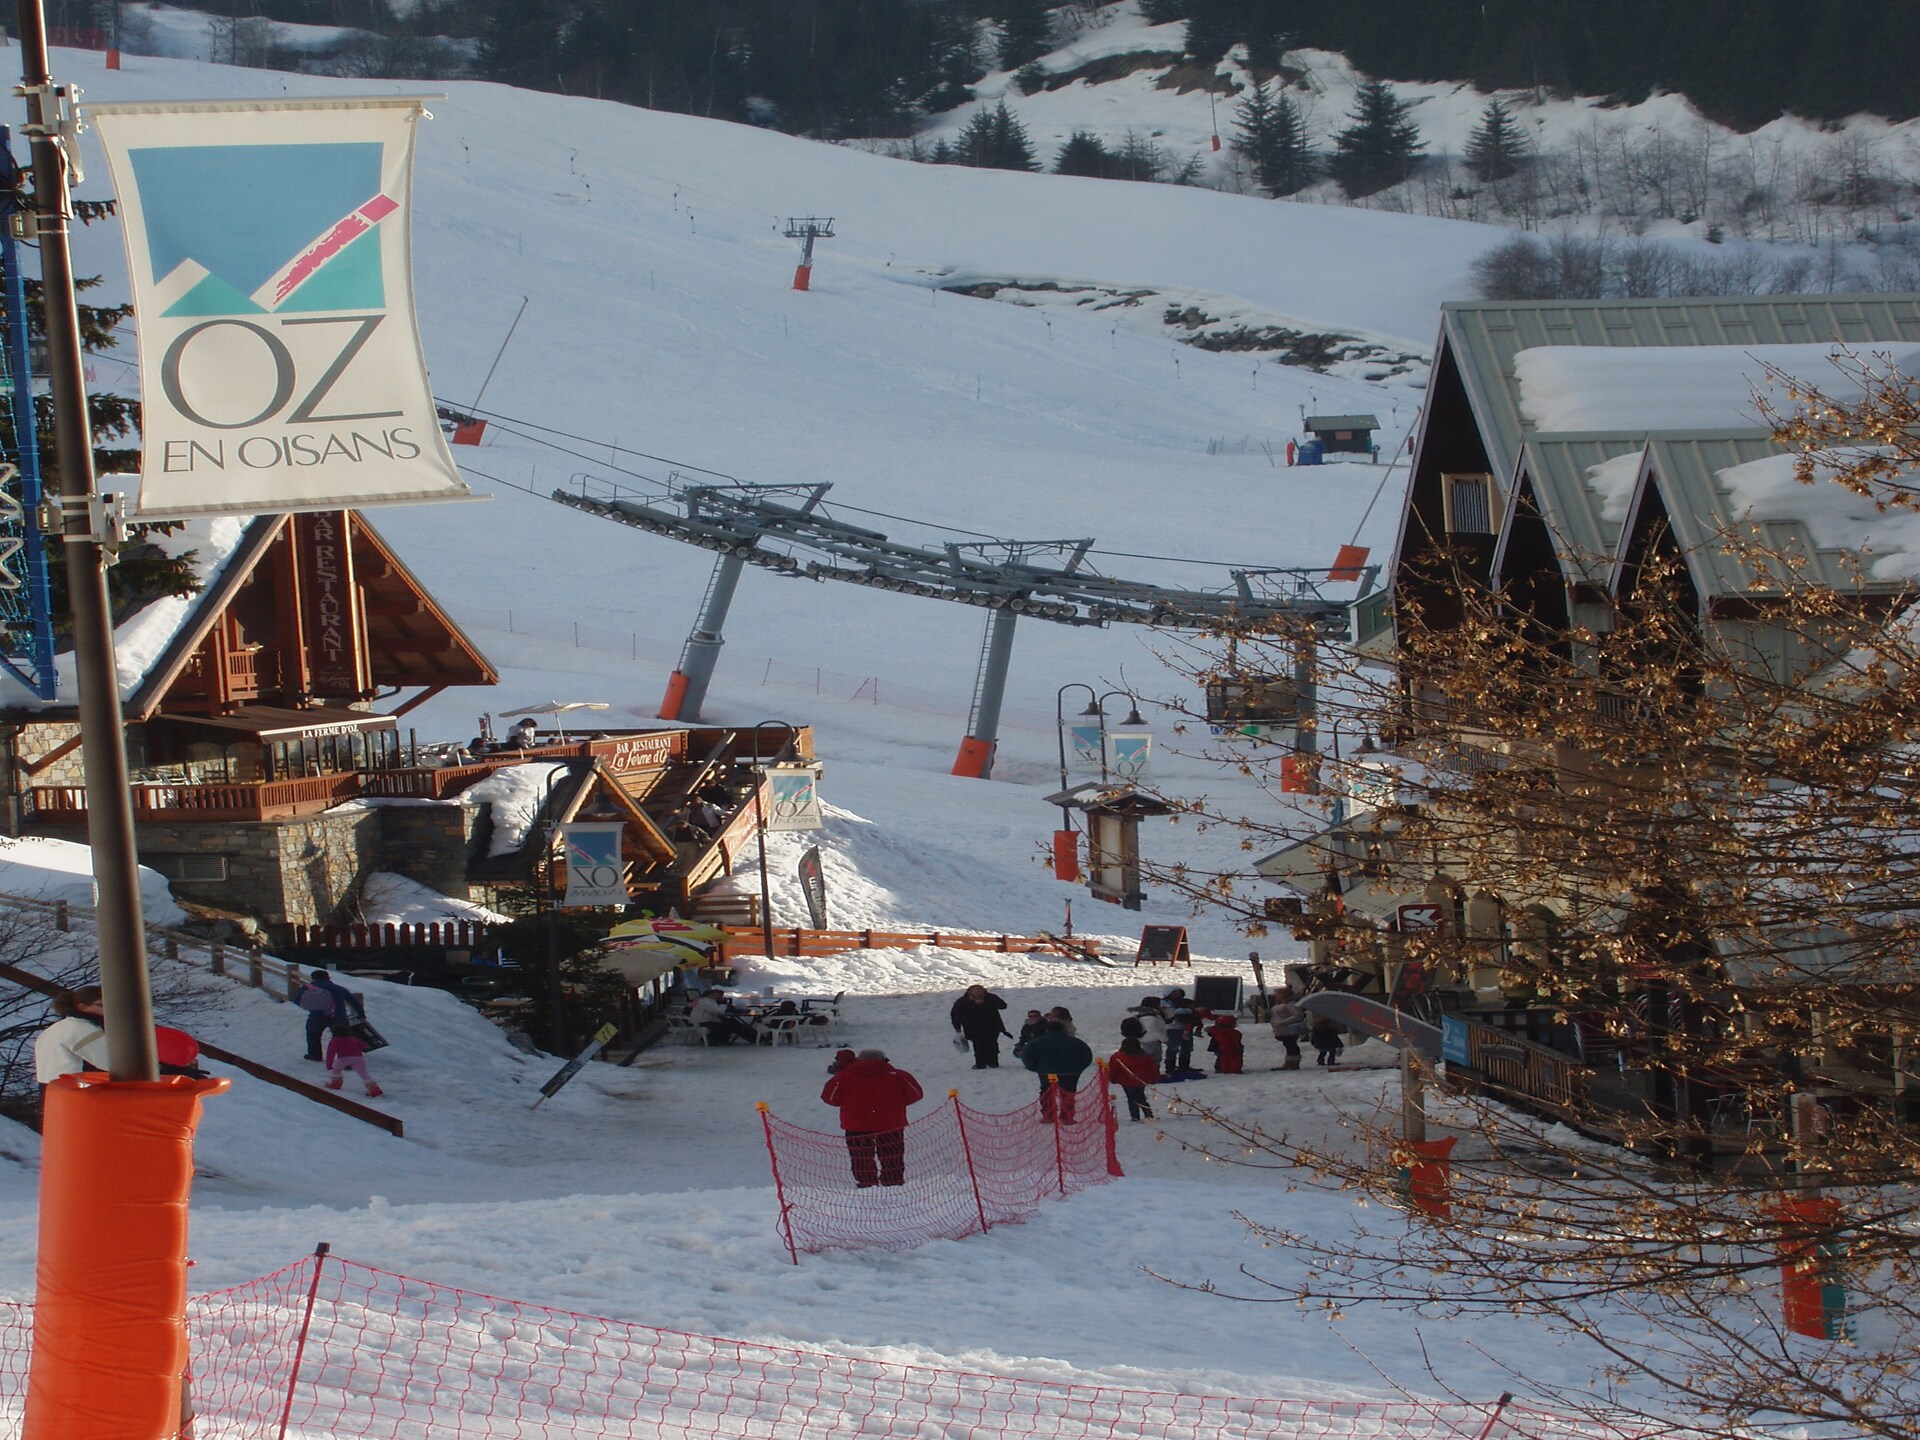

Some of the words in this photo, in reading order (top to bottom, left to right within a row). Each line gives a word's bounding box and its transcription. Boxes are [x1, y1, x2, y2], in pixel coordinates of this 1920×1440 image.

[160, 314, 404, 429] OZ
[162, 439, 225, 473] EN
[237, 427, 421, 469] OISANS
[315, 545, 343, 662] RESTAURANT
[302, 729, 313, 739] LA
[314, 726, 340, 737] FERME
[616, 742, 630, 755] BAR
[632, 736, 671, 752] RESTAURANT
[609, 753, 624, 771] La
[622, 748, 652, 772] ferme
[775, 800, 815, 818] OZ
